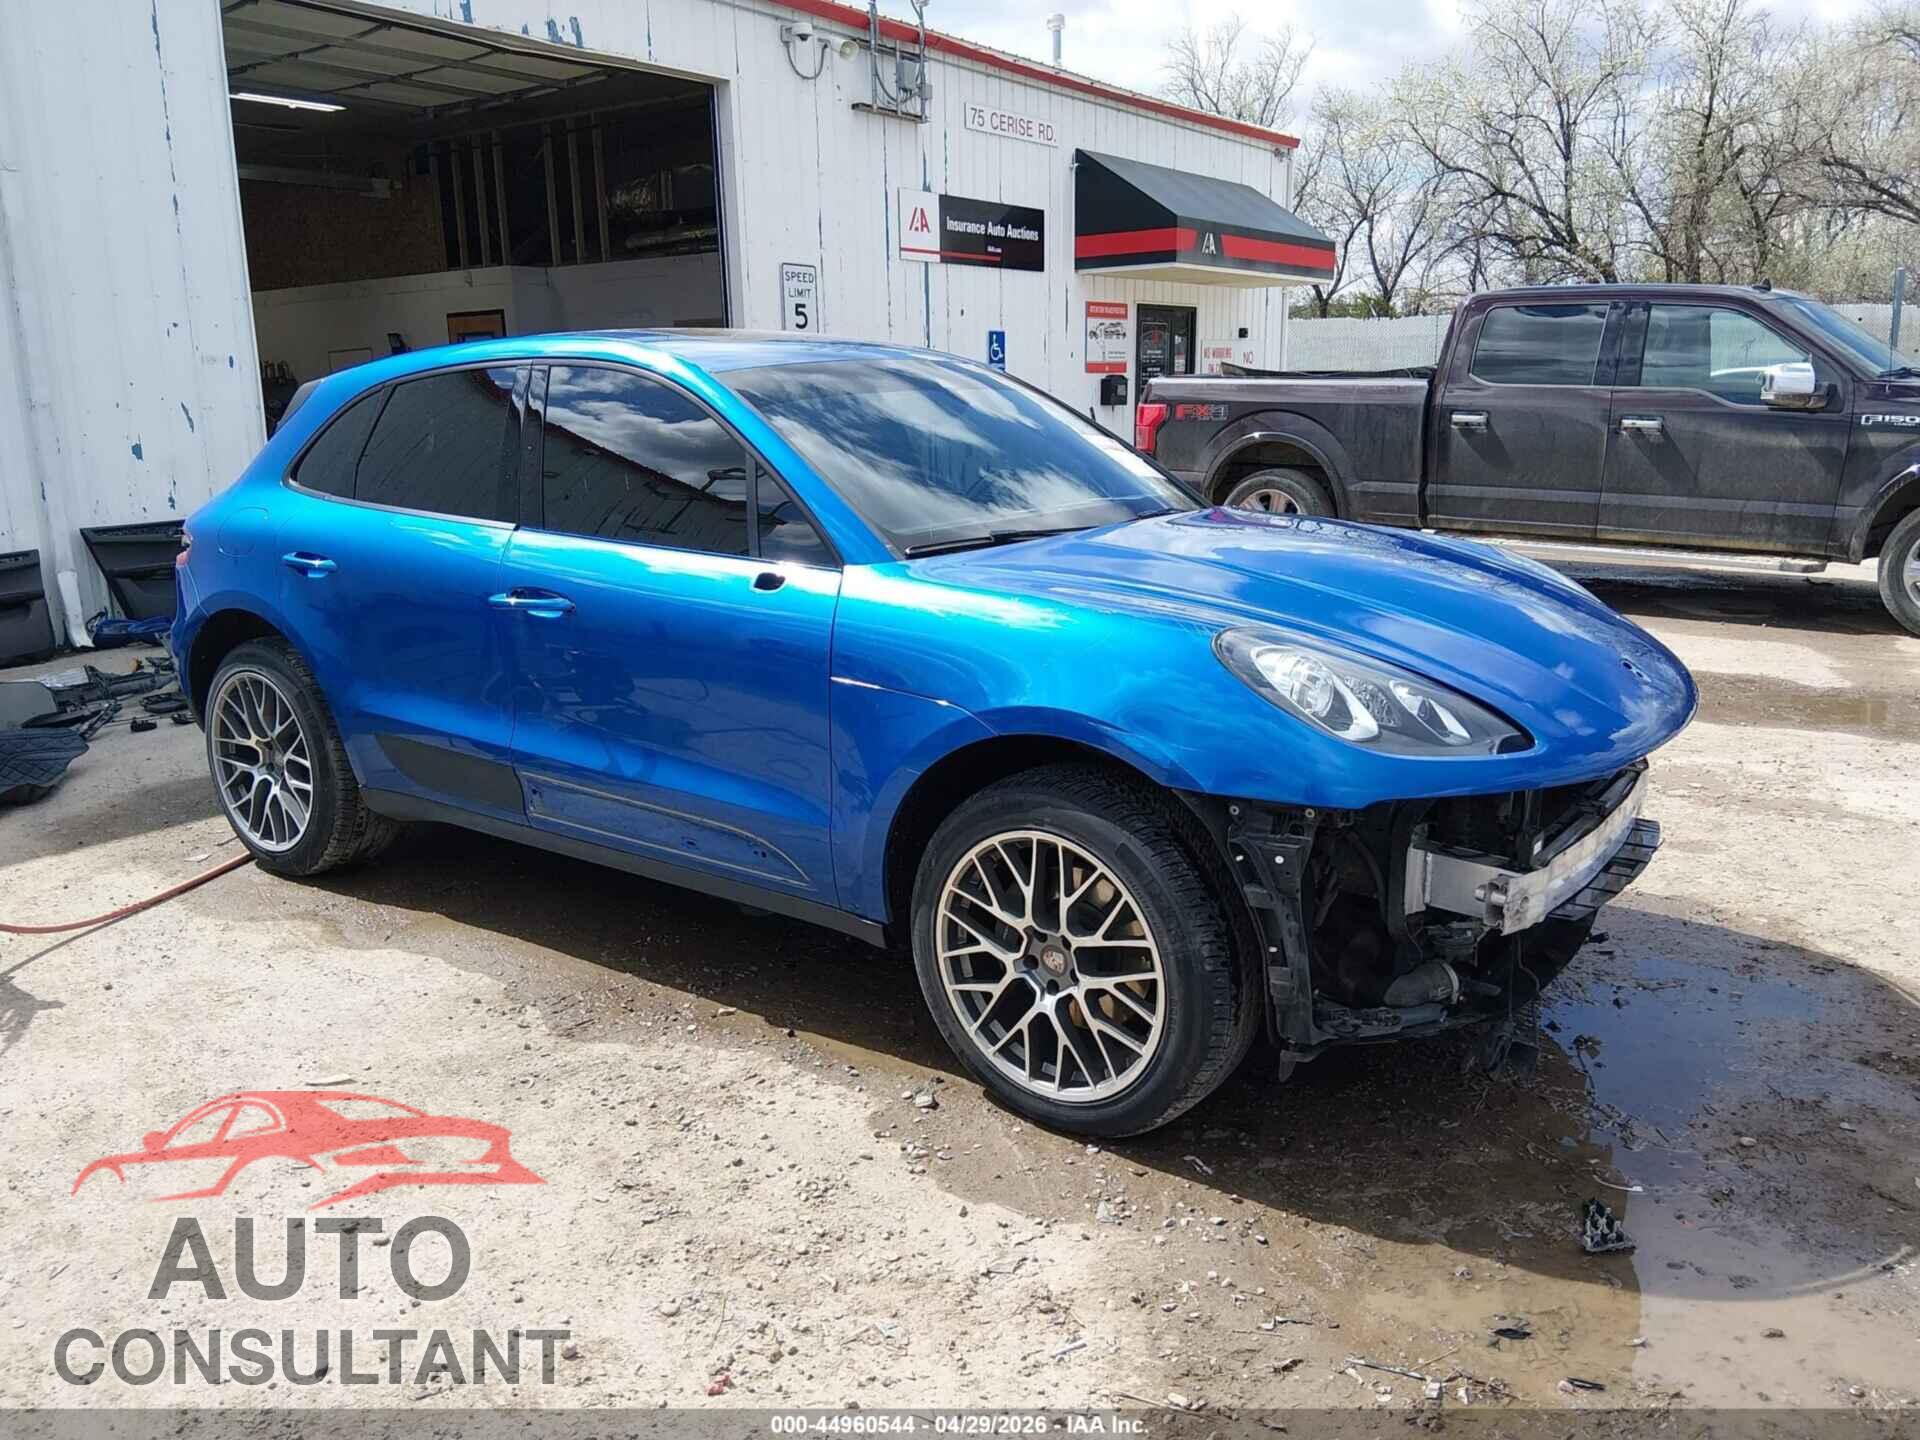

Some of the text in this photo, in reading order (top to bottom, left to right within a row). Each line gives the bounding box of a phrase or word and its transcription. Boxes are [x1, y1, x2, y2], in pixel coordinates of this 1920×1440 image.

[969, 106, 1057, 143] 75 CERISE RD.
[946, 215, 1039, 241] Insurance Auto Auctions
[785, 271, 815, 284] SPEED
[788, 287, 812, 299] LIMIT
[795, 303, 808, 329] 5
[1243, 351, 1254, 365] NO
[1175, 403, 1230, 418] FX4
